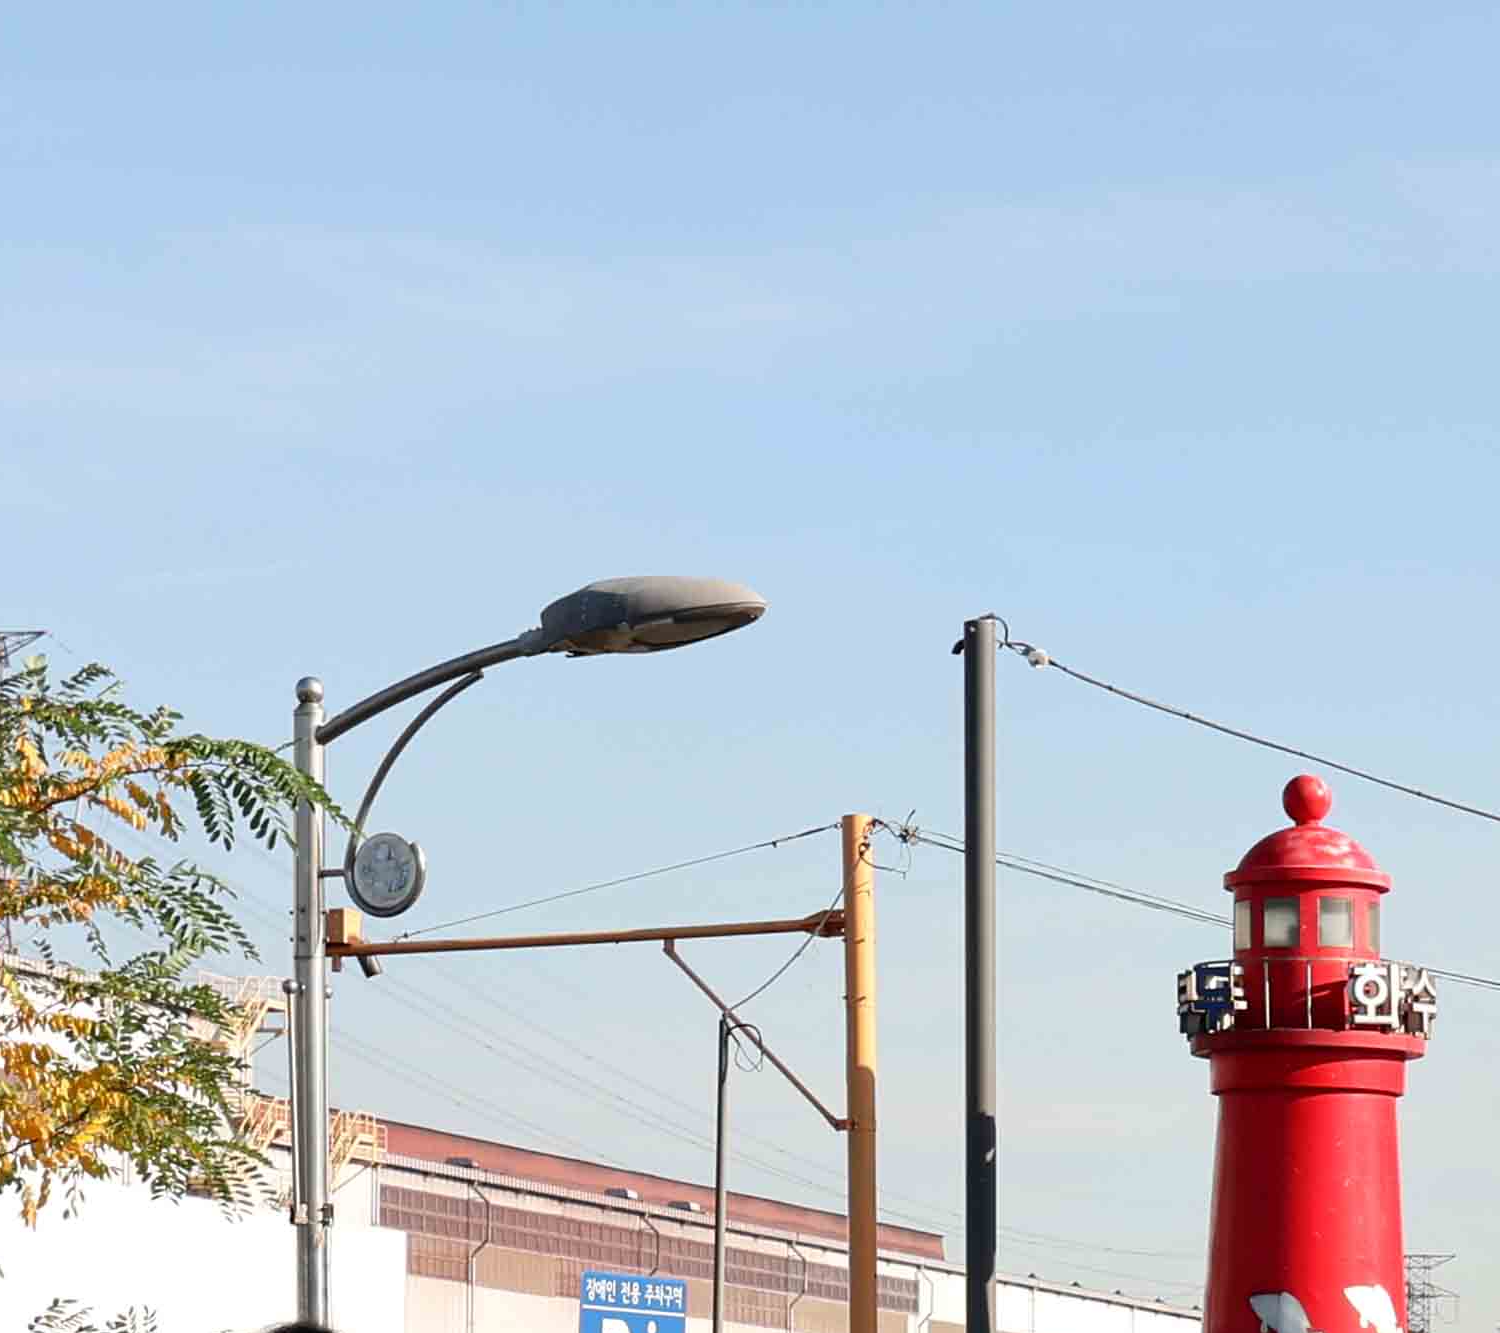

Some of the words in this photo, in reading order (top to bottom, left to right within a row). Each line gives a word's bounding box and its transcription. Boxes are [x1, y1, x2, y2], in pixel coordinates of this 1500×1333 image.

[585, 1278, 617, 1303] 장애인
[620, 1282, 641, 1305] 전용
[644, 1284, 683, 1309] 주차구역
